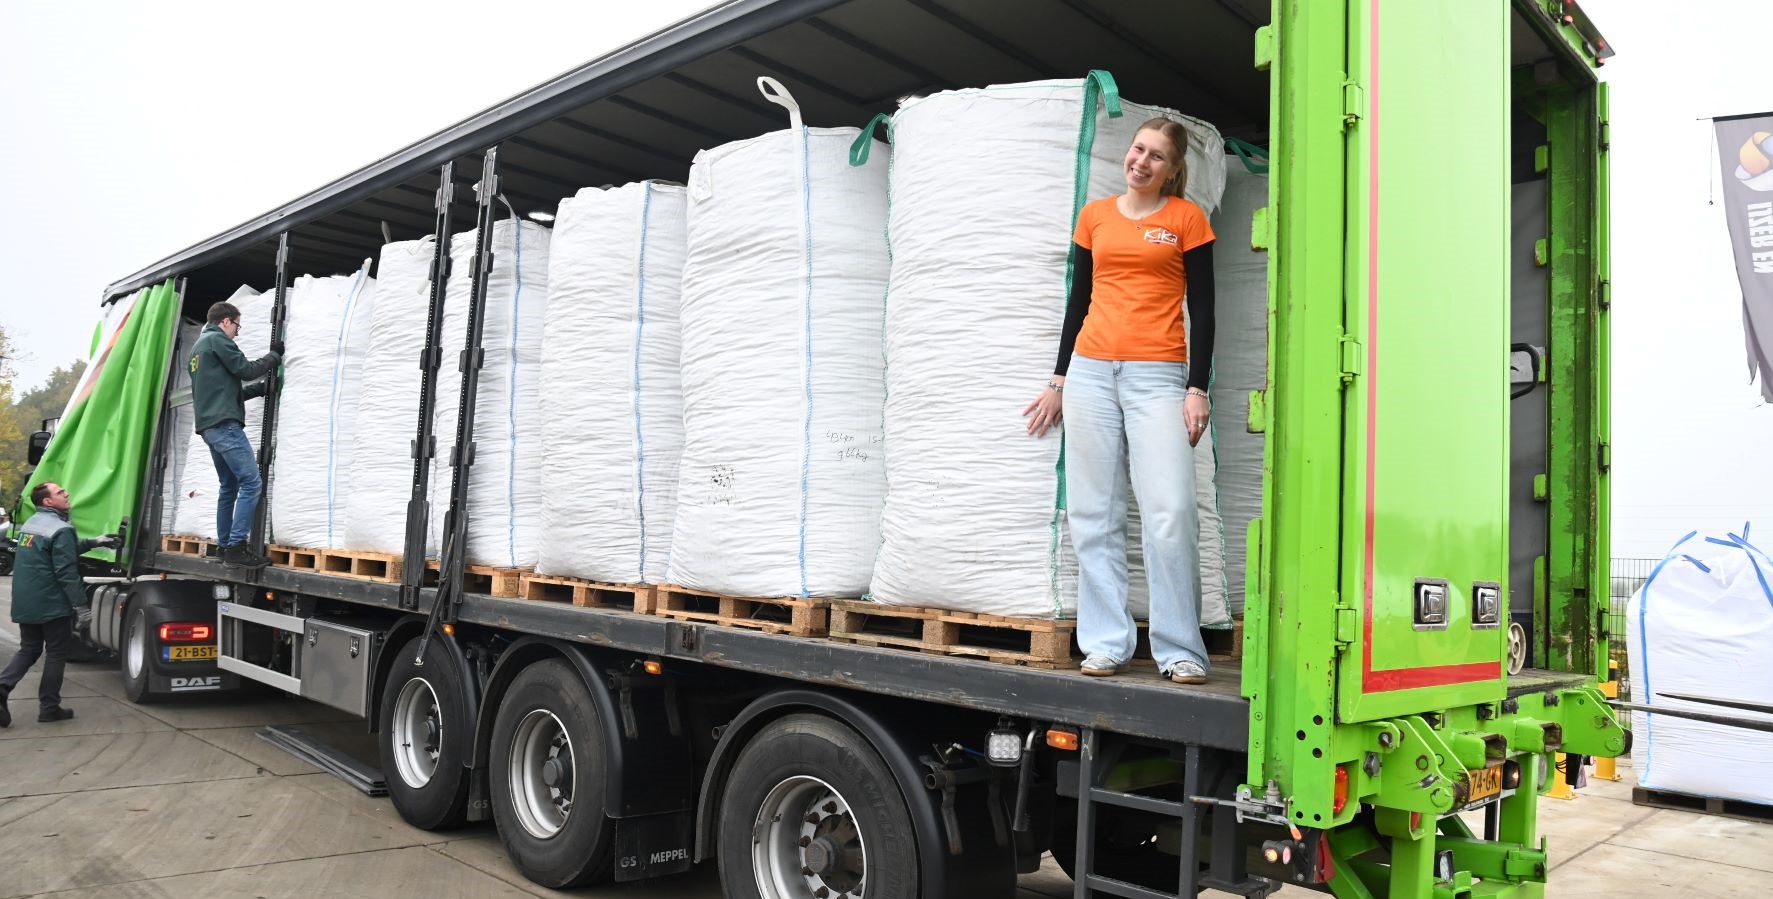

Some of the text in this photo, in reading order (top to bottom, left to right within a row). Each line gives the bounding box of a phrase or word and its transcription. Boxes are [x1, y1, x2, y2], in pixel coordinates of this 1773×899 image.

[175, 647, 218, 658] 21-BST-
[171, 677, 220, 687] DAF
[1471, 766, 1498, 796] 74-GK
[620, 848, 689, 868] GS MEPPEL
